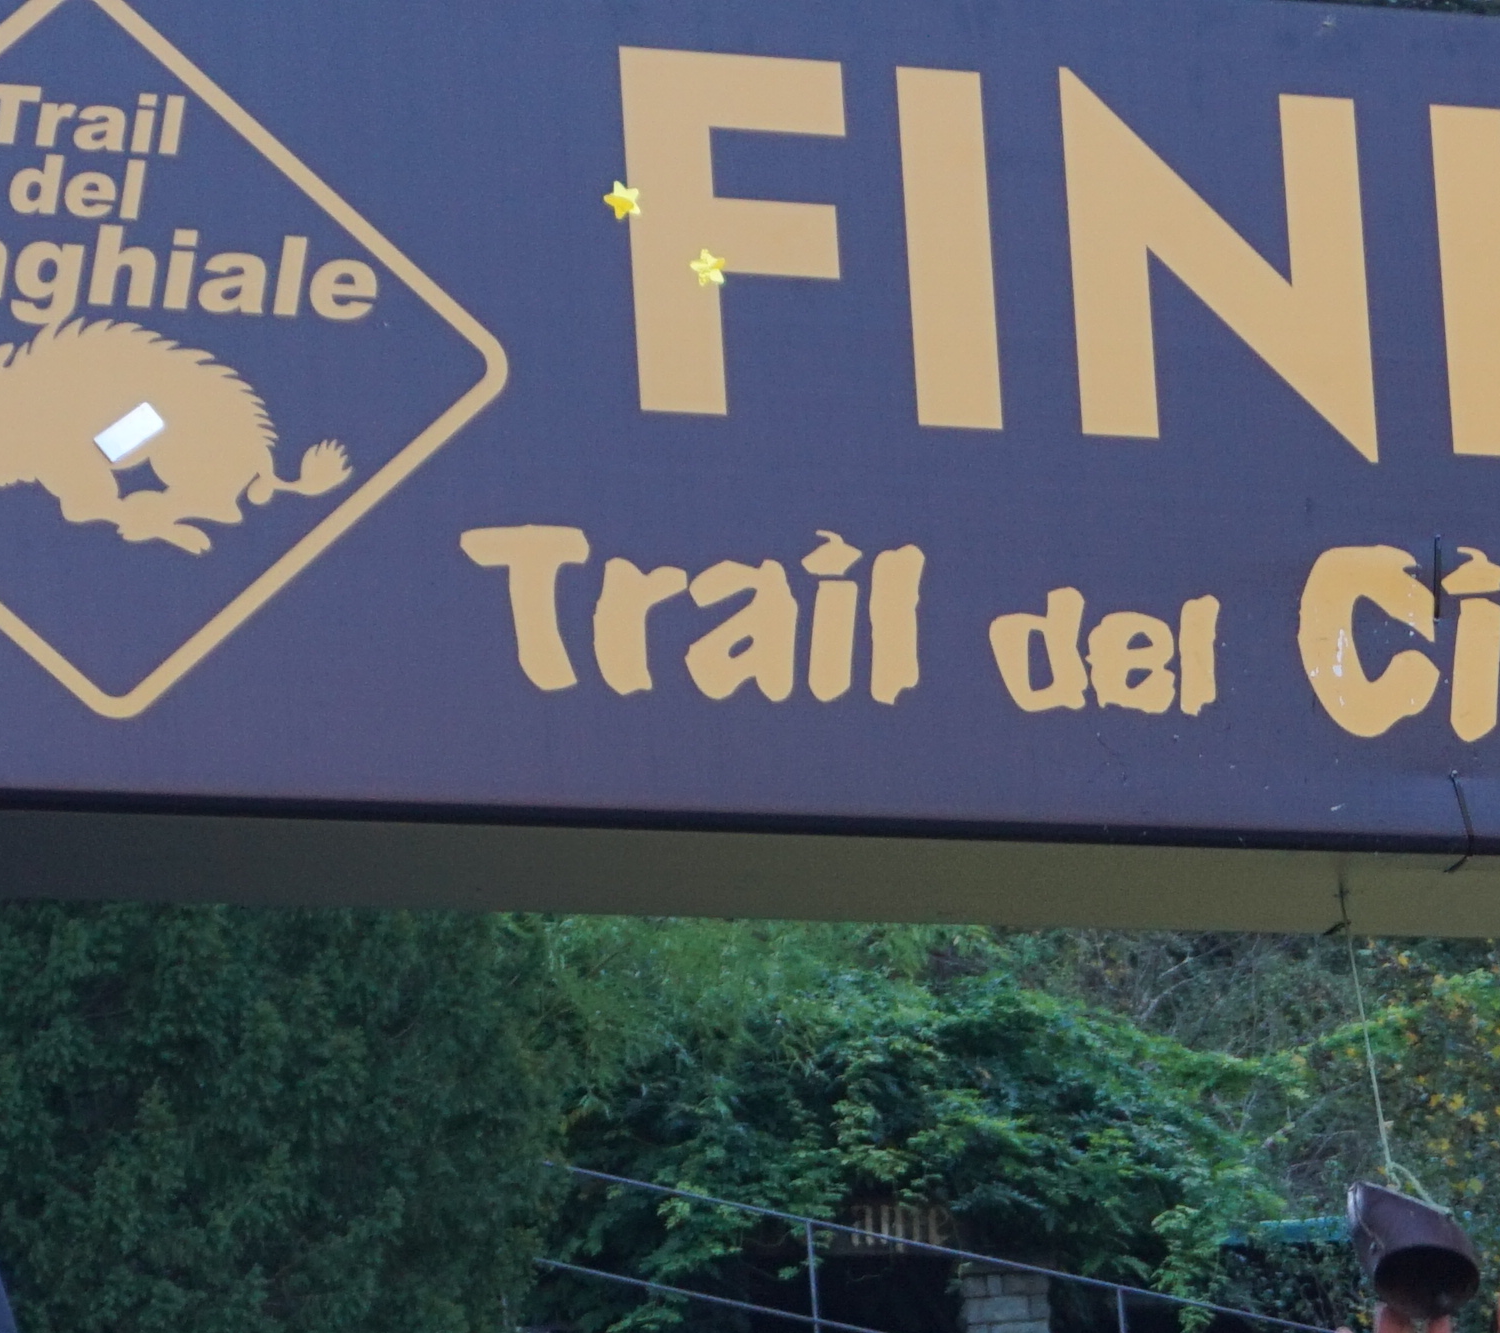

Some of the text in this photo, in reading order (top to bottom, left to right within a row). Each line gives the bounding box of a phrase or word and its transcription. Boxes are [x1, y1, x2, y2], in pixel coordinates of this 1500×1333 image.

[9, 152, 146, 223] del
[459, 523, 925, 707] Trail
[989, 586, 1219, 717] del
